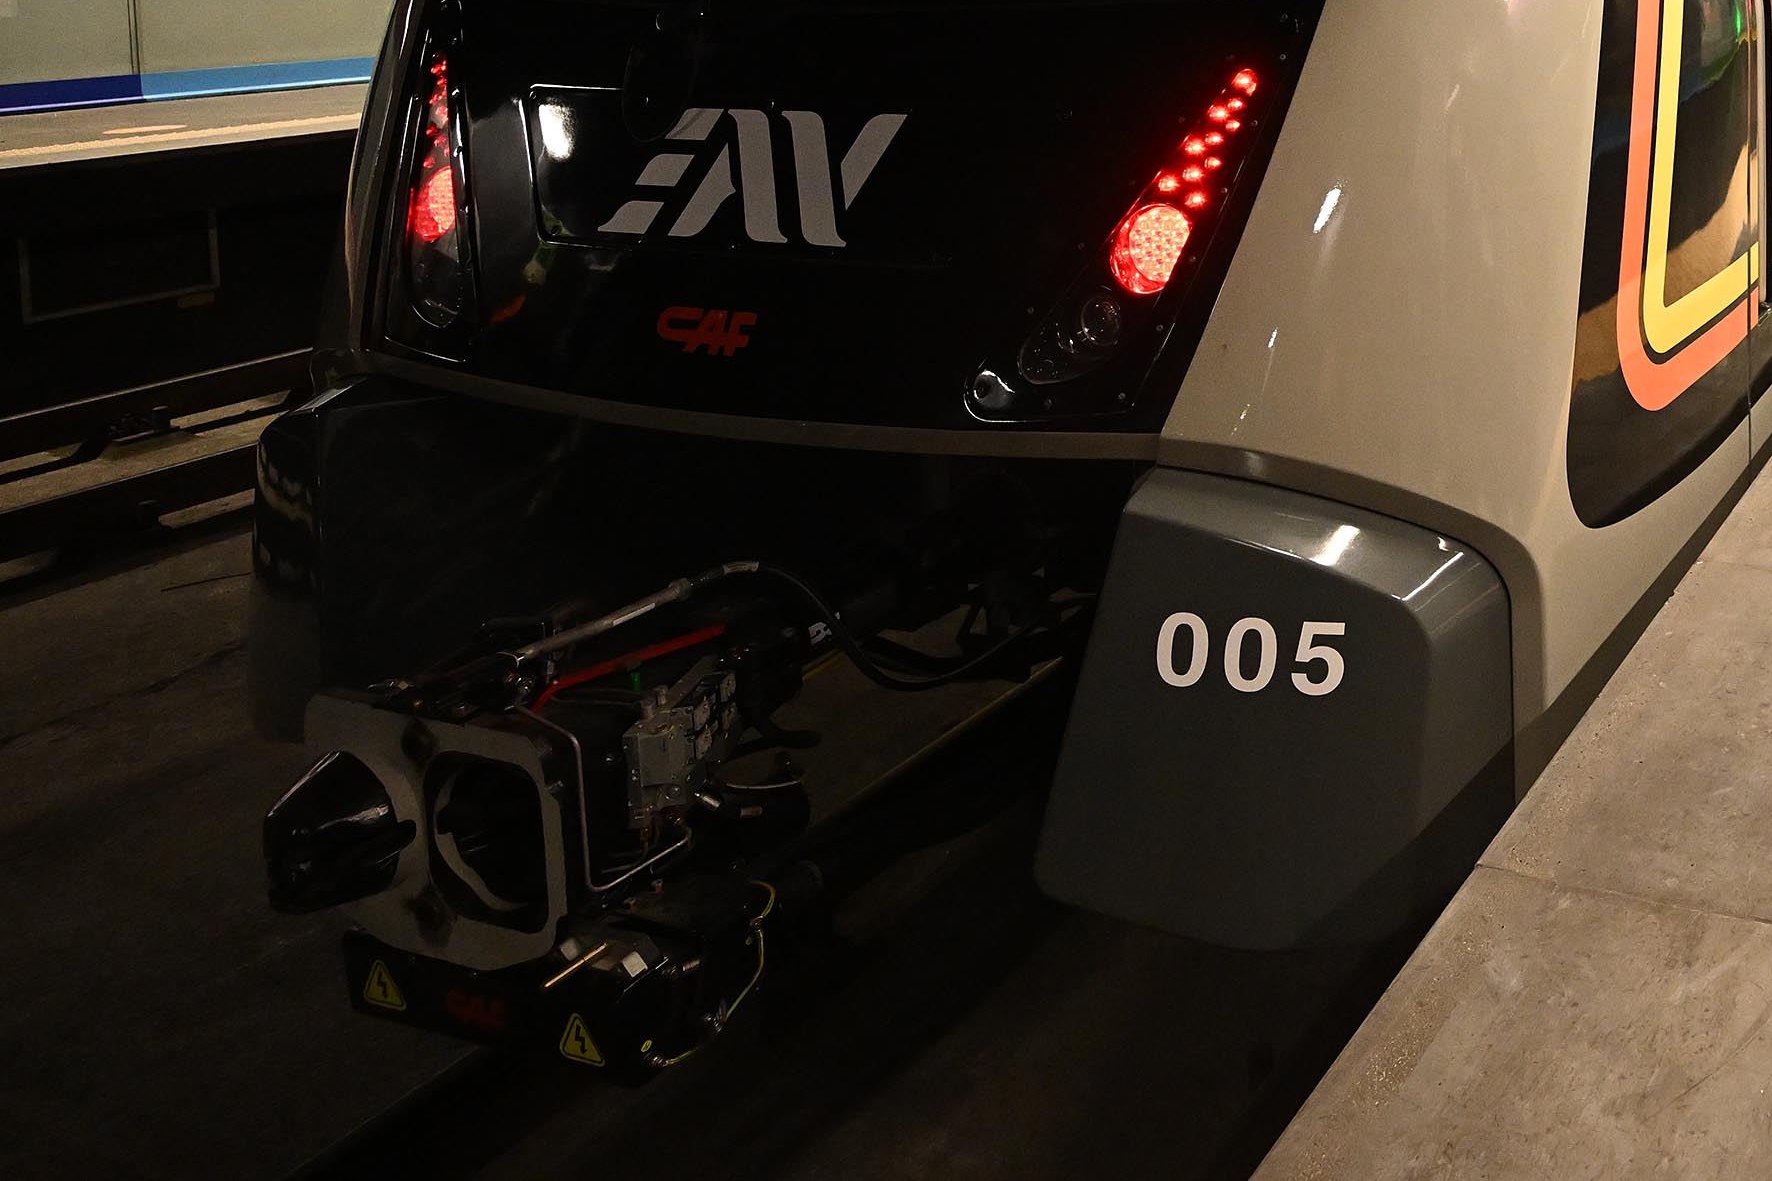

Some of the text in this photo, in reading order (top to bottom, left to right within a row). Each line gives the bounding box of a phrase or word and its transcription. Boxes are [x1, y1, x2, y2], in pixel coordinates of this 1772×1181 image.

[598, 108, 908, 247] EAV
[657, 306, 757, 356] CAF
[1156, 612, 1346, 696] 005
